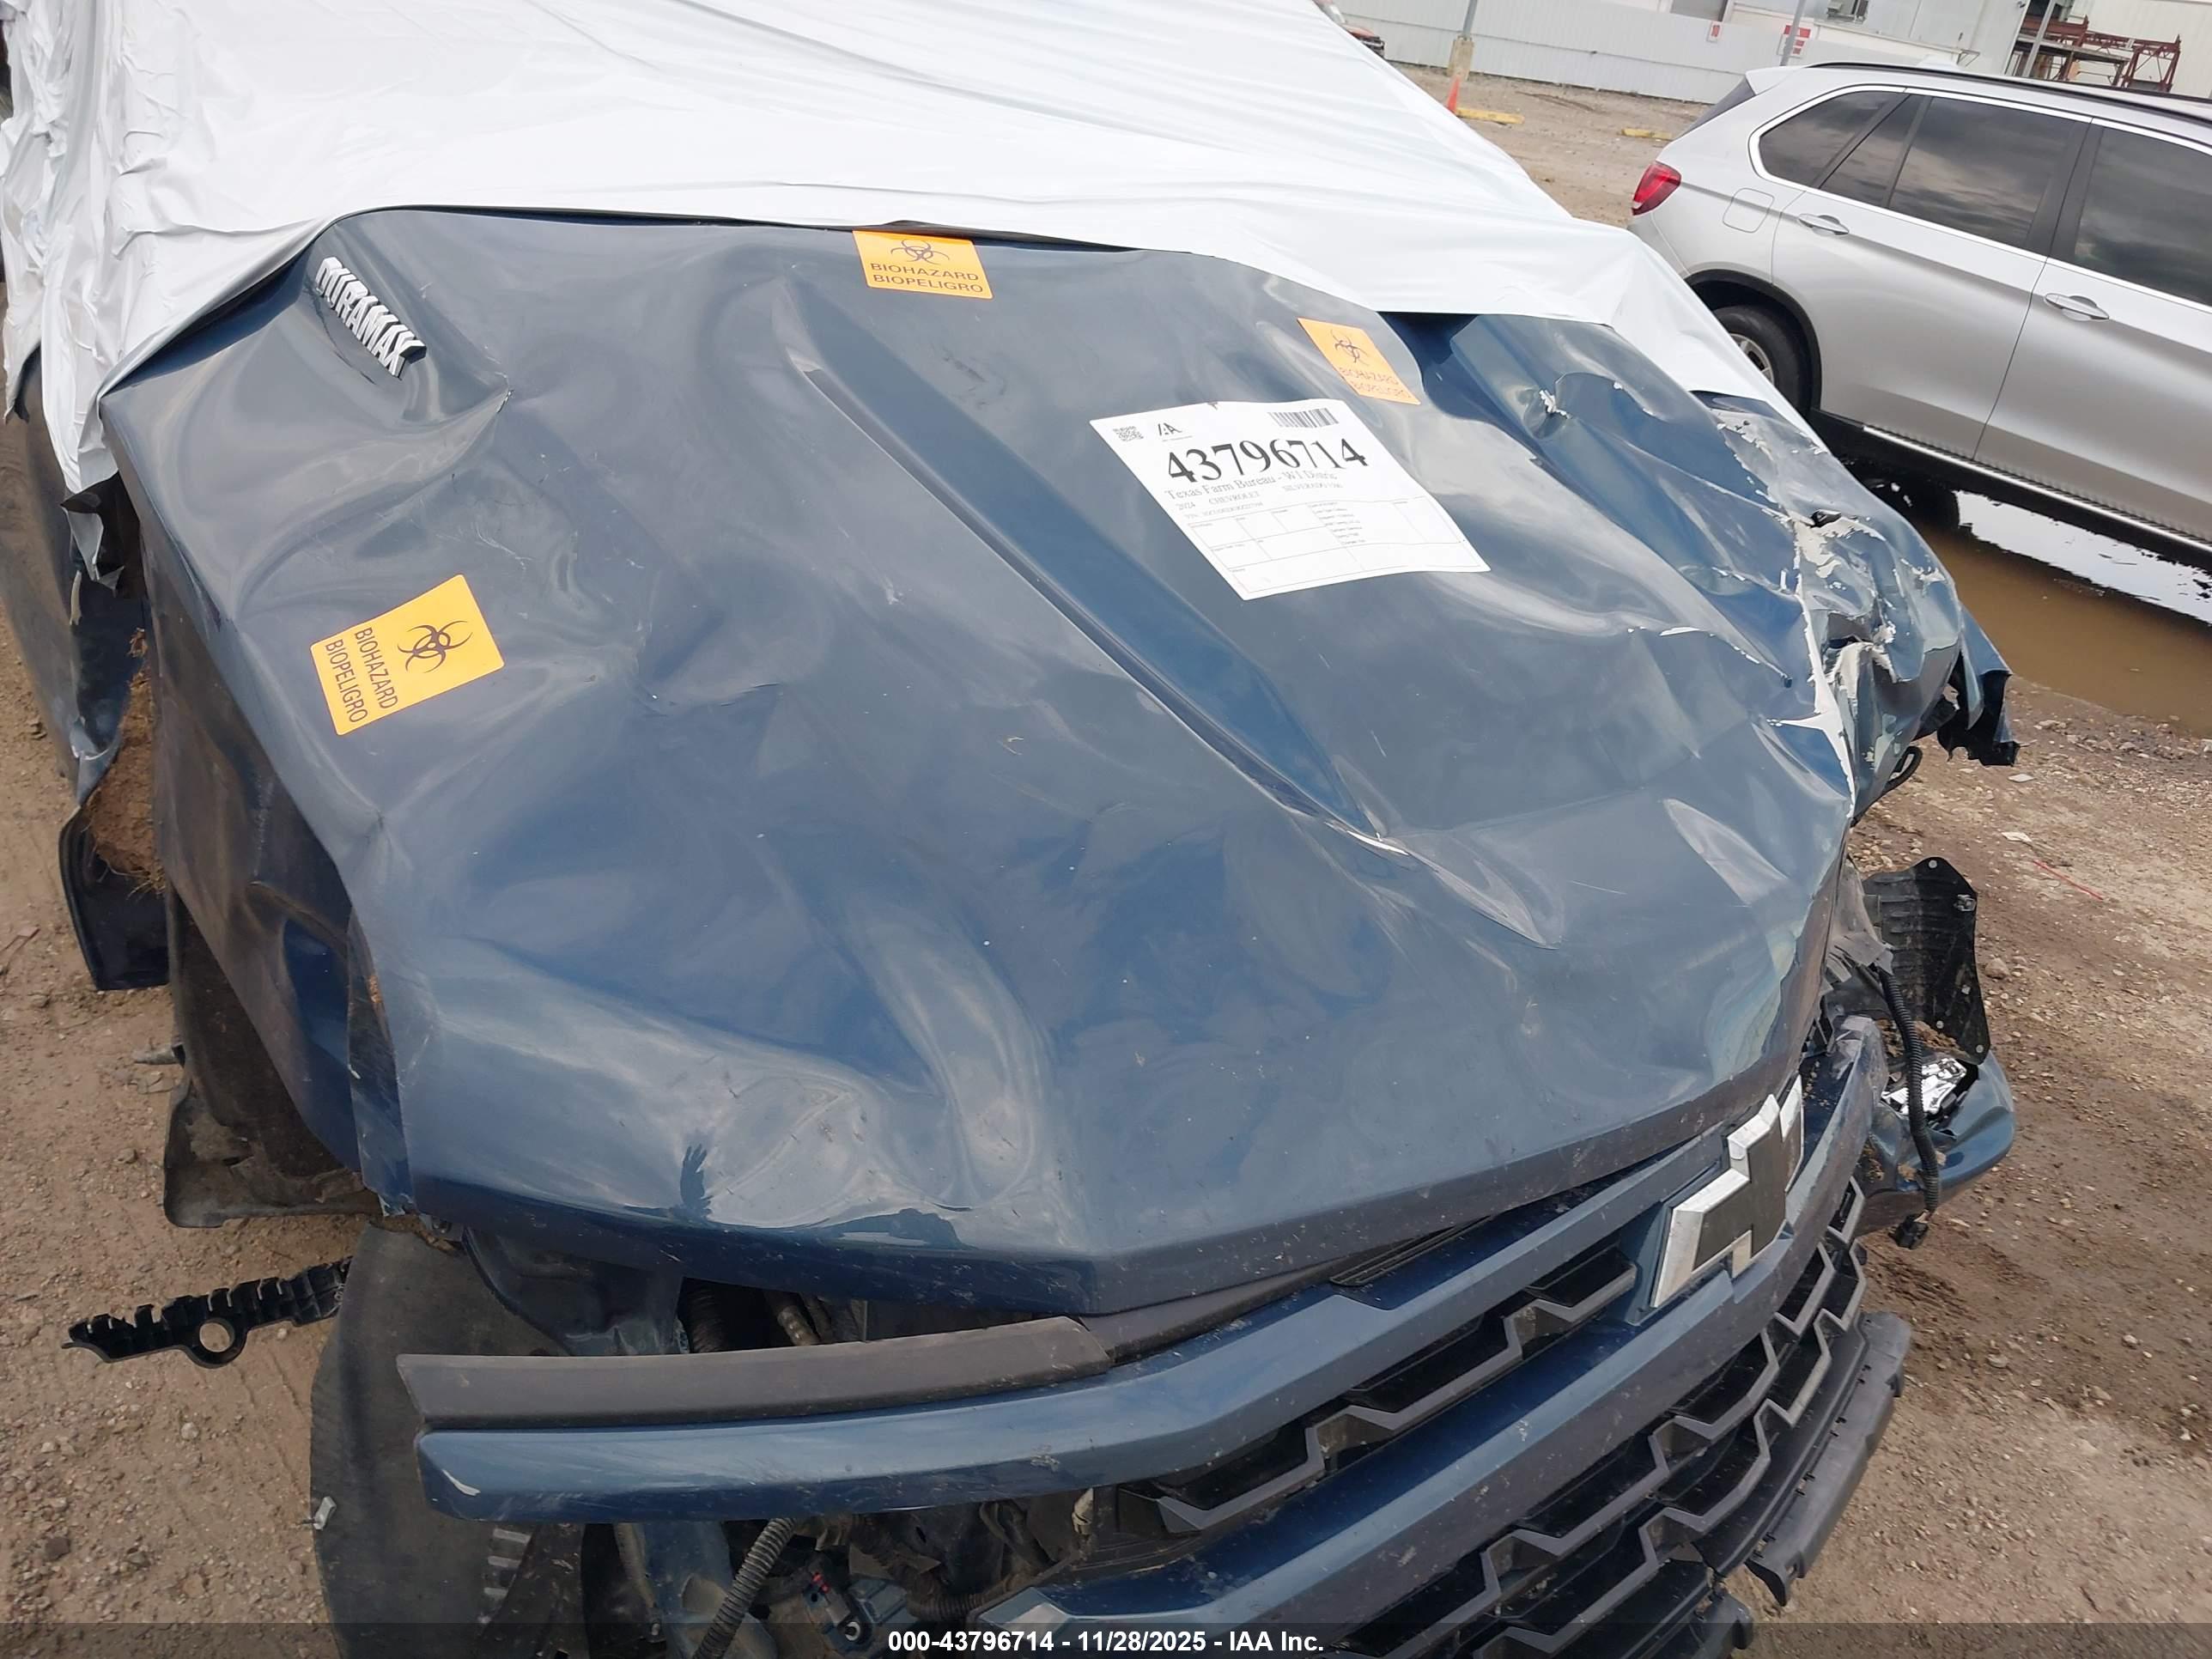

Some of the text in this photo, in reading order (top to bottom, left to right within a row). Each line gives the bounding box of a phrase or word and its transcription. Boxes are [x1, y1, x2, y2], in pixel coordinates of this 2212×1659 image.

[870, 263, 979, 282] BIOHAZARD
[873, 274, 983, 293] BIOPELIGRO
[315, 257, 427, 379] DURAMAX
[1168, 438, 1369, 483] 43796714
[1164, 489, 1203, 500] Texas
[1201, 483, 1235, 495] Farm
[325, 639, 368, 723] BIOPELIGRO
[355, 627, 398, 709] BIOHAZARD
